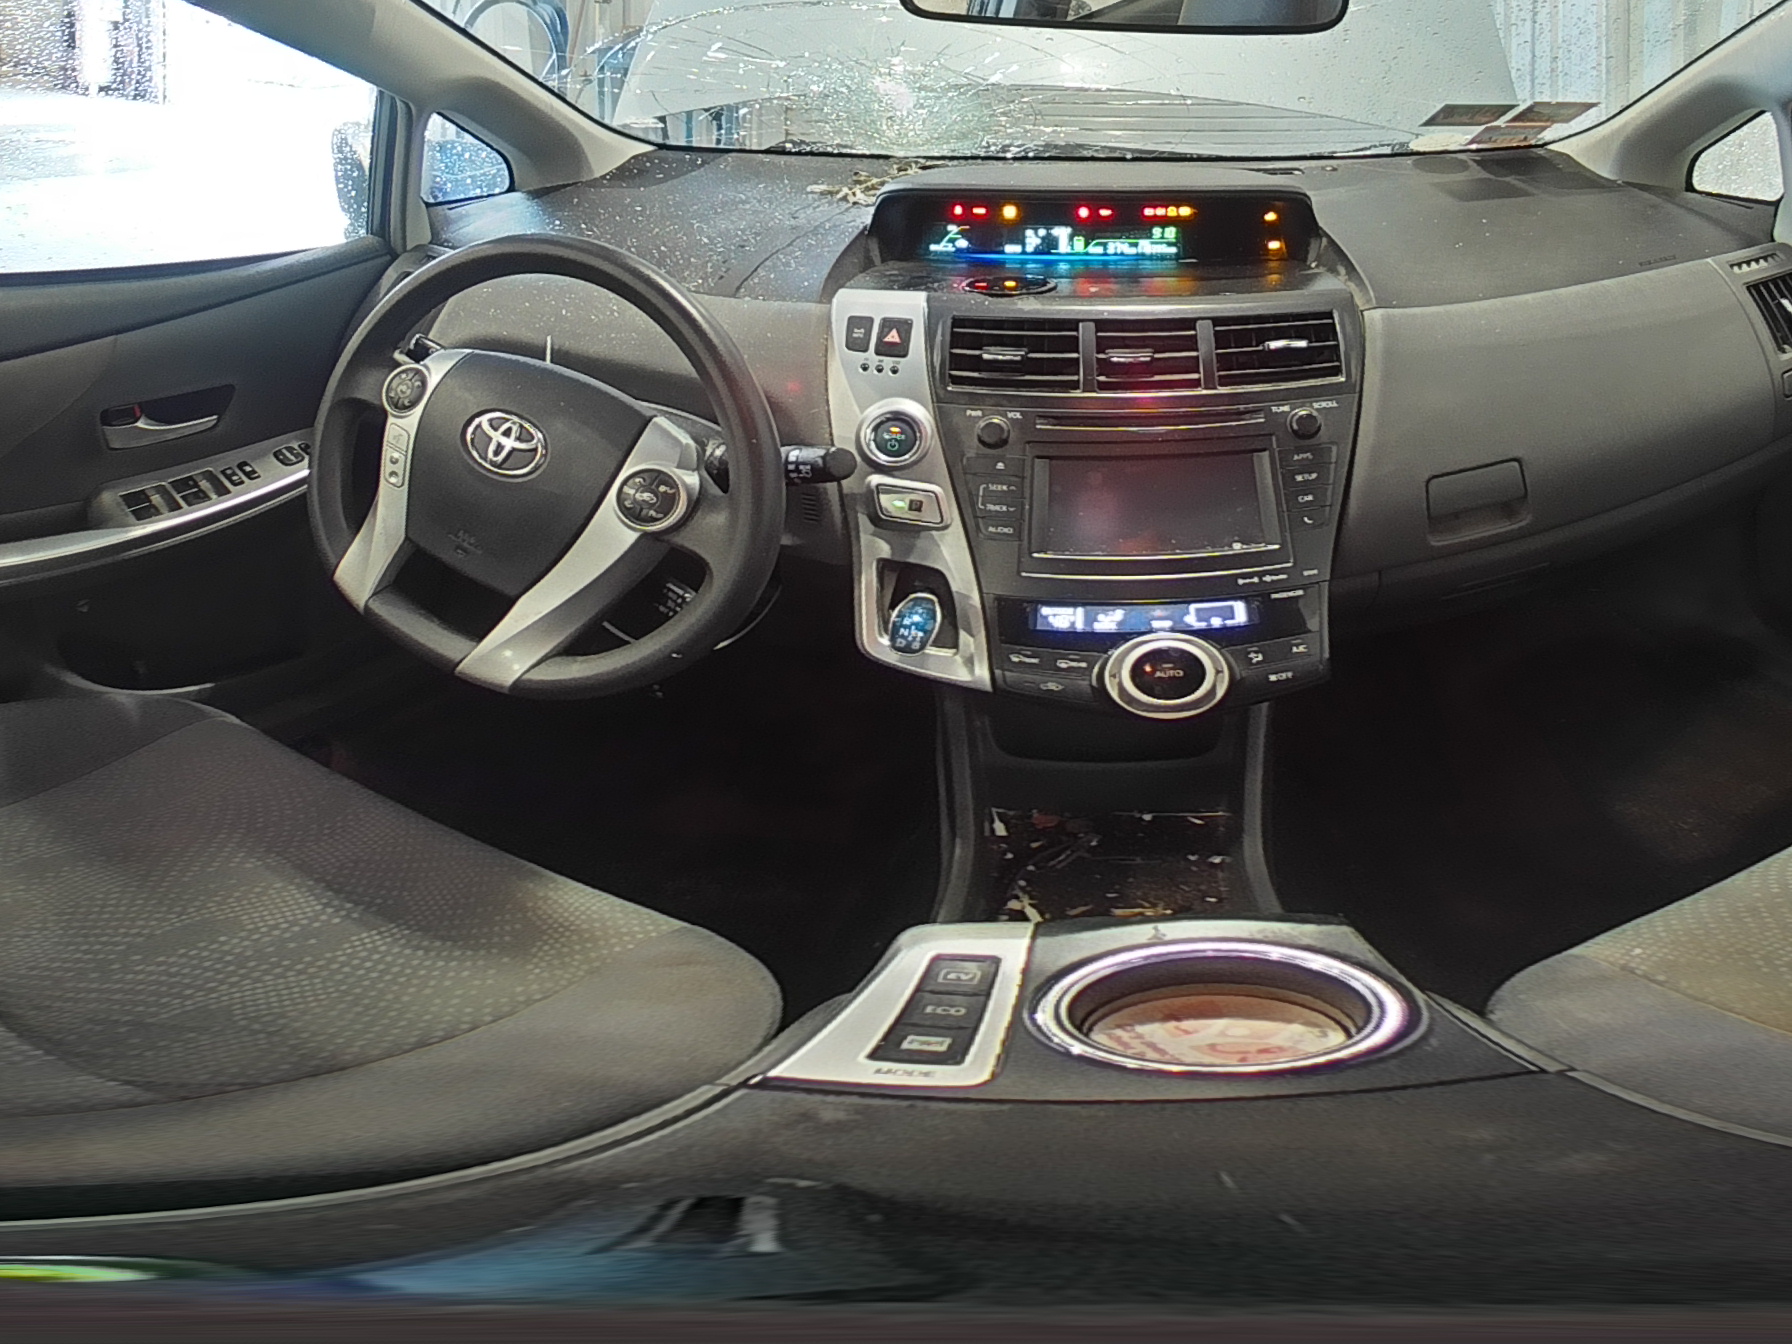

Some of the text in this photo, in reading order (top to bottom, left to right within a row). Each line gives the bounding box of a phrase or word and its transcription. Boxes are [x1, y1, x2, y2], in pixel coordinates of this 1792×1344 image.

[1271, 405, 1291, 413] TUNE
[1312, 400, 1338, 409] SCROLL
[1007, 411, 1023, 419] VOL
[1294, 472, 1318, 481] SETUP
[1297, 494, 1314, 503] CAR
[988, 526, 1014, 534] AUDIO
[1154, 669, 1184, 678] AUTO
[924, 1005, 967, 1016] ECO
